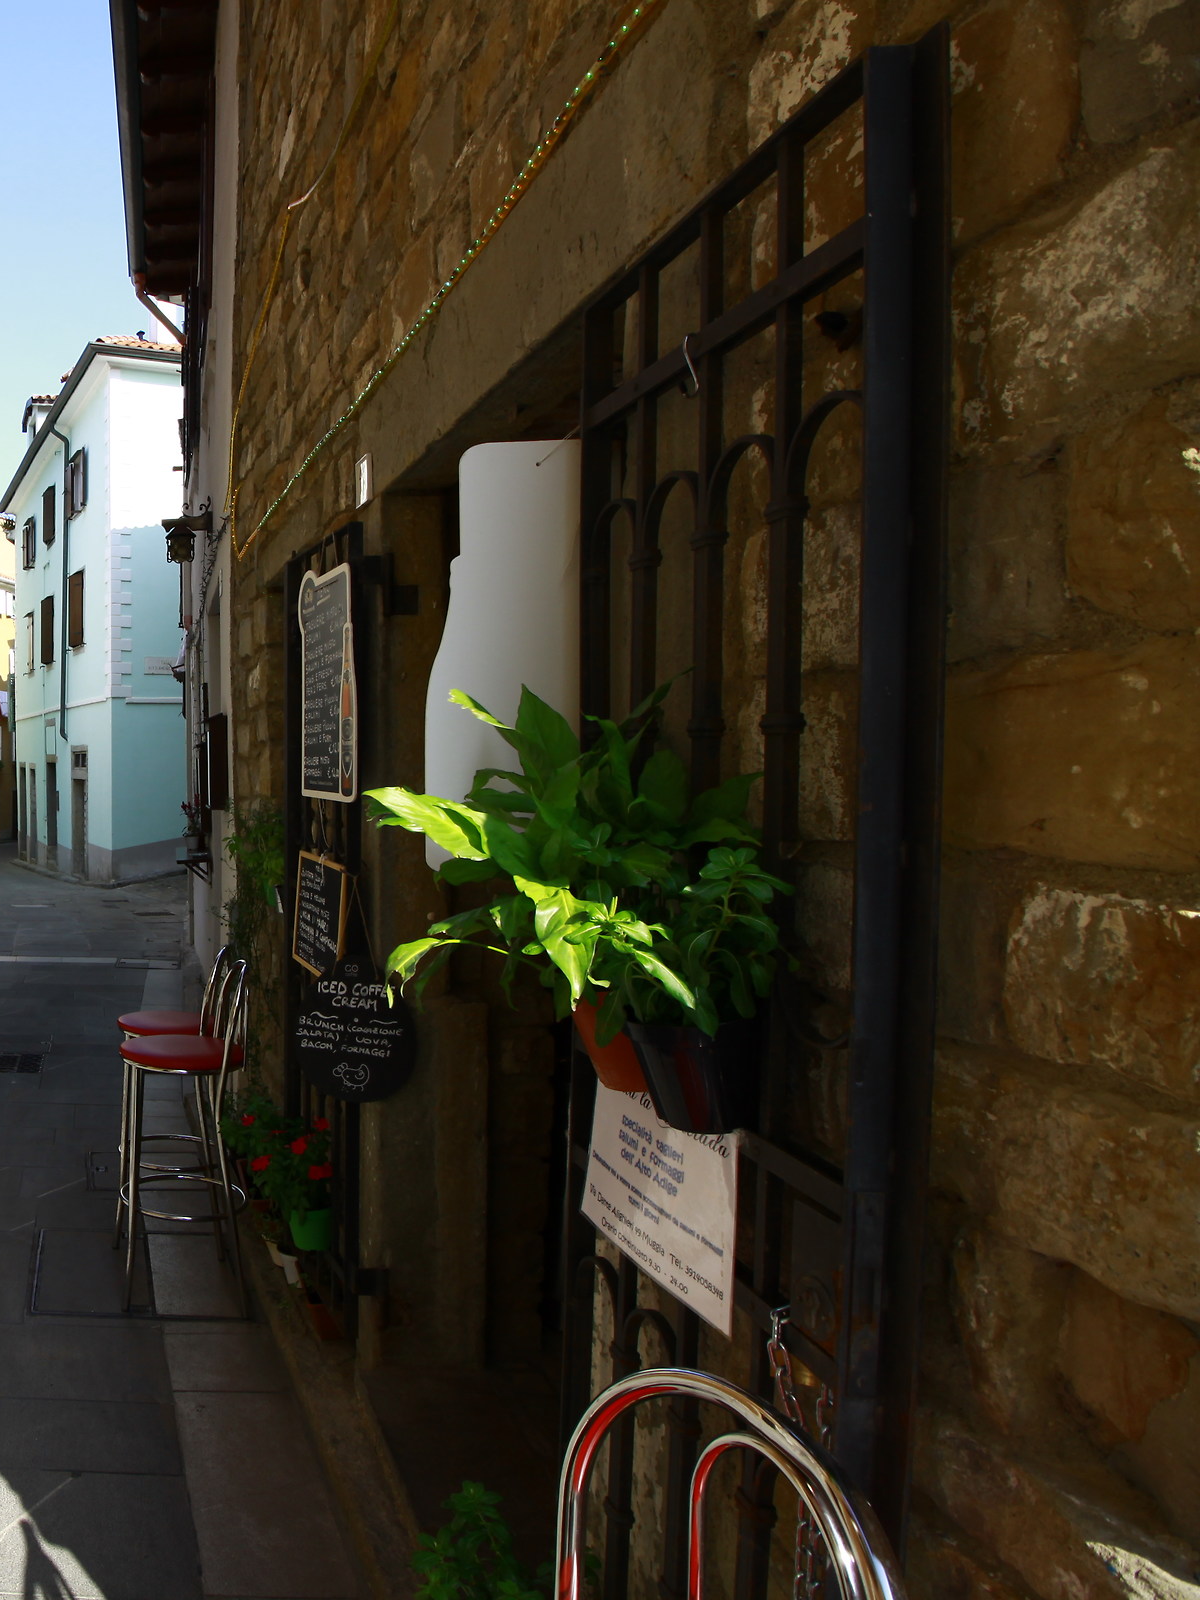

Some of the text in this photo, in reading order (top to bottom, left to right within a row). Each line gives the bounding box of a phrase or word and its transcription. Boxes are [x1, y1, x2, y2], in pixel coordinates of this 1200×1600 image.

[317, 981, 348, 995] ICED
[331, 996, 378, 1012] CREAM
[296, 1028, 340, 1042] SALATA)
[355, 1035, 393, 1048] UOVA,
[299, 1016, 345, 1032] BRUNCH
[300, 1038, 391, 1058] BACON, FORMAGGI
[622, 1114, 653, 1145] specialità
[656, 1138, 684, 1165] taglieri
[619, 1129, 685, 1184] salumi e formaggi
[634, 1158, 652, 1178] Alto
[653, 1172, 678, 1197] Adige
[589, 1182, 597, 1197] Via
[597, 1191, 612, 1211] Dante
[612, 1205, 634, 1231] Alighieri
[642, 1231, 665, 1256] Muggia
[669, 1252, 683, 1270] Tel.
[601, 1216, 618, 1236] Orario
[617, 1231, 649, 1263] continuato
[648, 1257, 661, 1274] 9.30
[670, 1275, 689, 1295] 24.00
